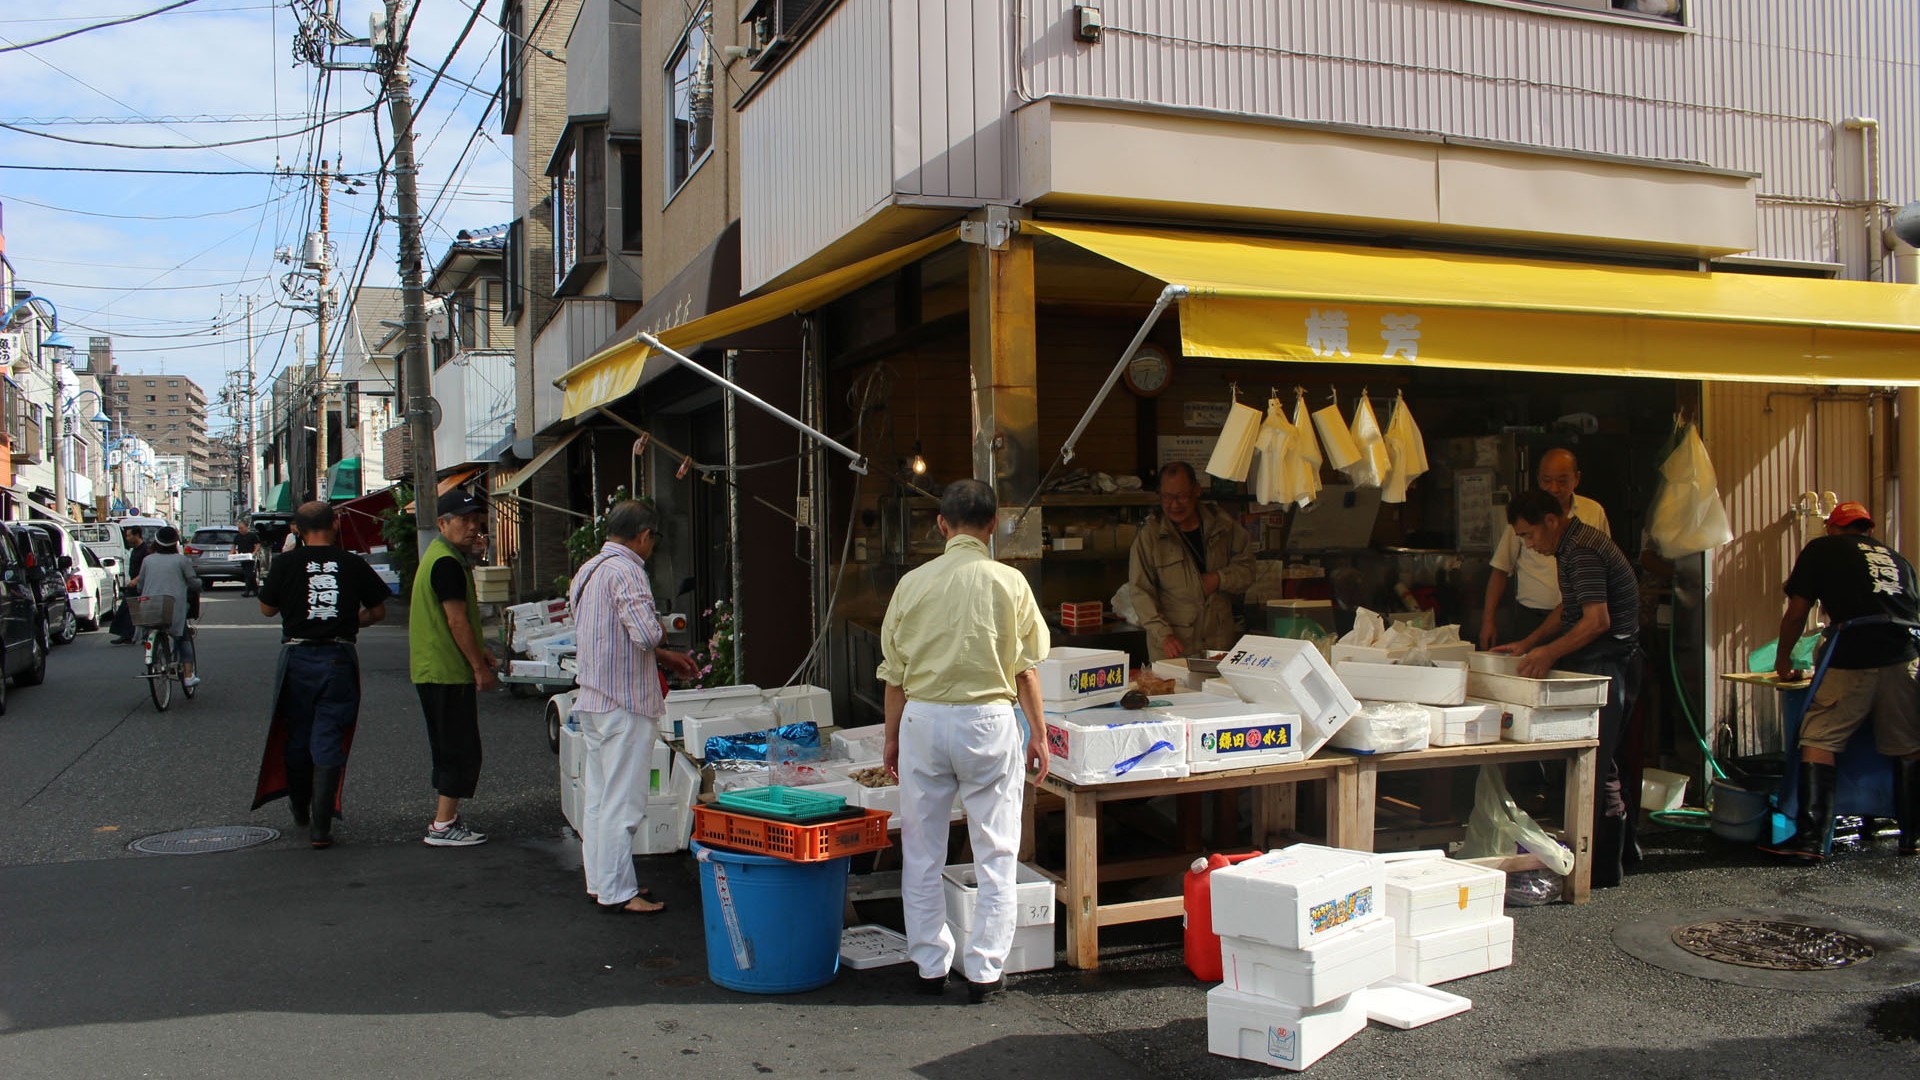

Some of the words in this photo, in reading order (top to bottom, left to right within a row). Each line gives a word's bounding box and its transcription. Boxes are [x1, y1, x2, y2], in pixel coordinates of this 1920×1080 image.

[1304, 308, 1421, 362] 横芳
[306, 561, 338, 573] 生麦
[307, 574, 339, 620] 魚河岸
